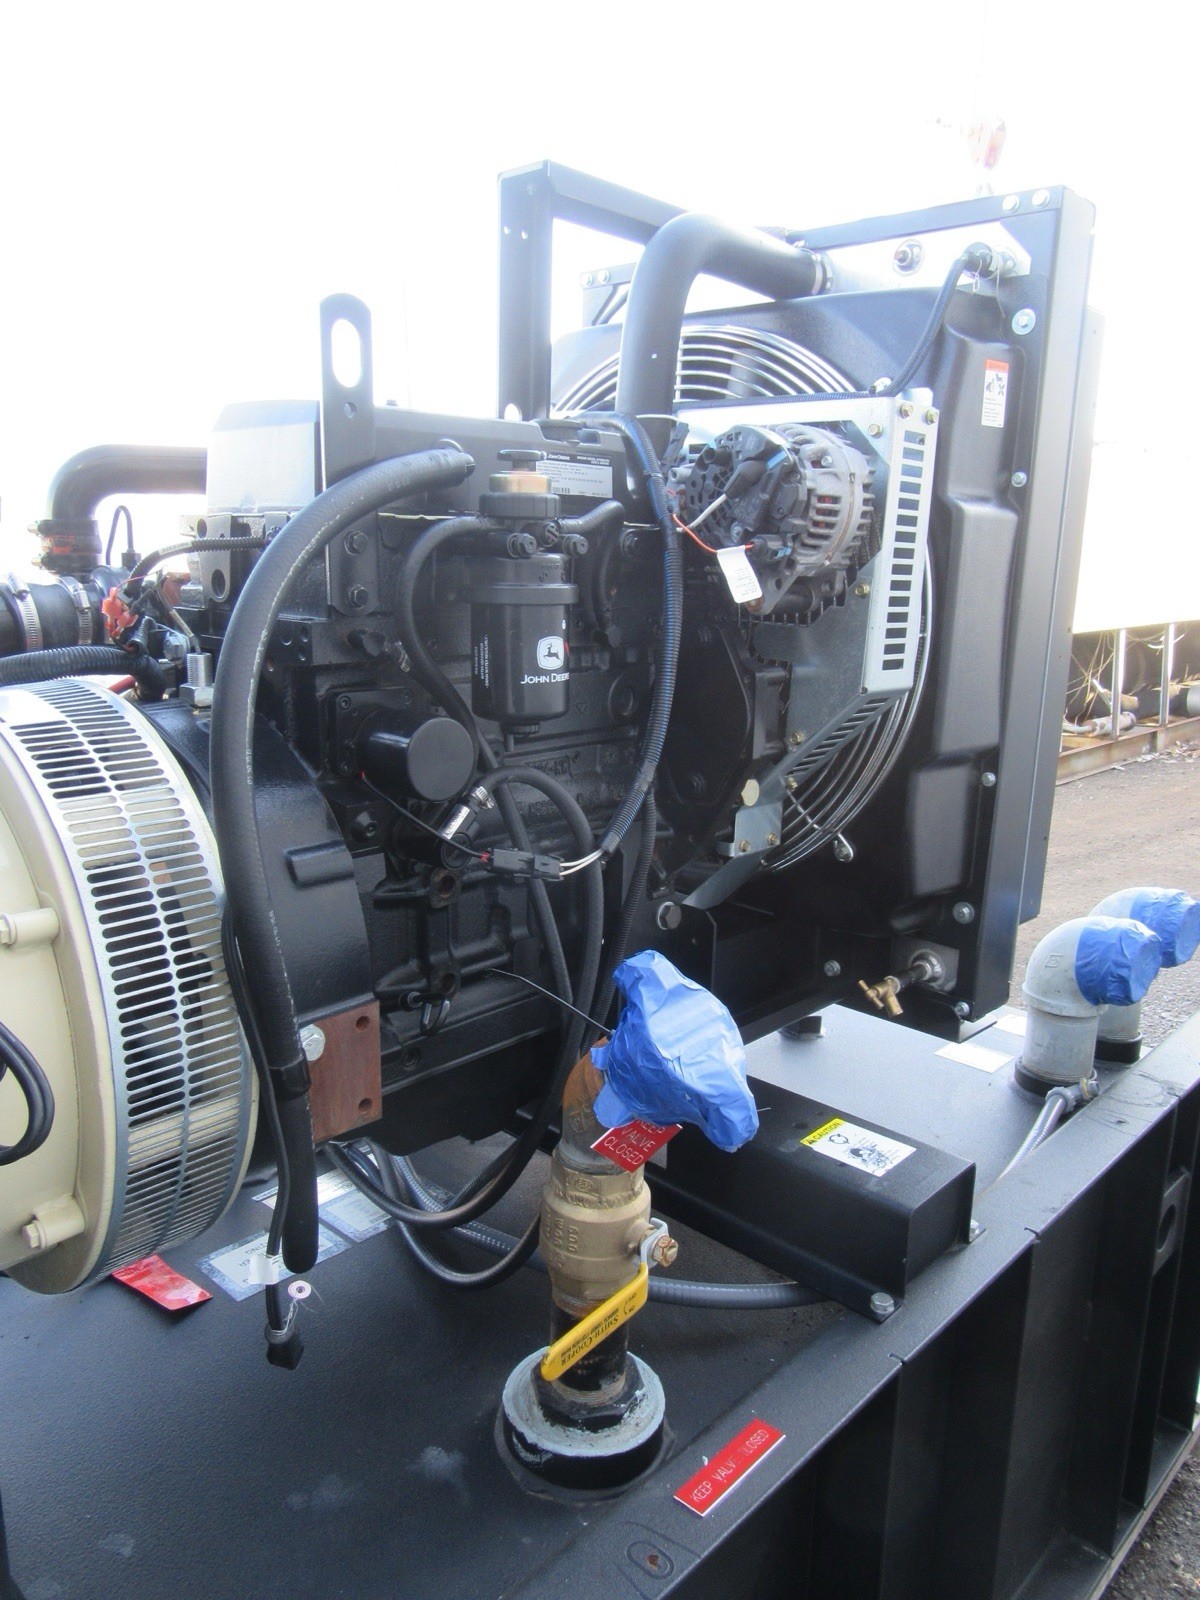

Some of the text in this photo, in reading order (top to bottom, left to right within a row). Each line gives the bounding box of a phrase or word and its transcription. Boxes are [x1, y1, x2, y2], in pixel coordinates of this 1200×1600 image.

[521, 675, 549, 684] JOHN
[621, 1127, 656, 1152] VALVE
[815, 1122, 842, 1140] CAUTION
[603, 1136, 644, 1165] CLOSED
[561, 1315, 619, 1366] SMITH-COOPER
[690, 1480, 713, 1503] KEEP
